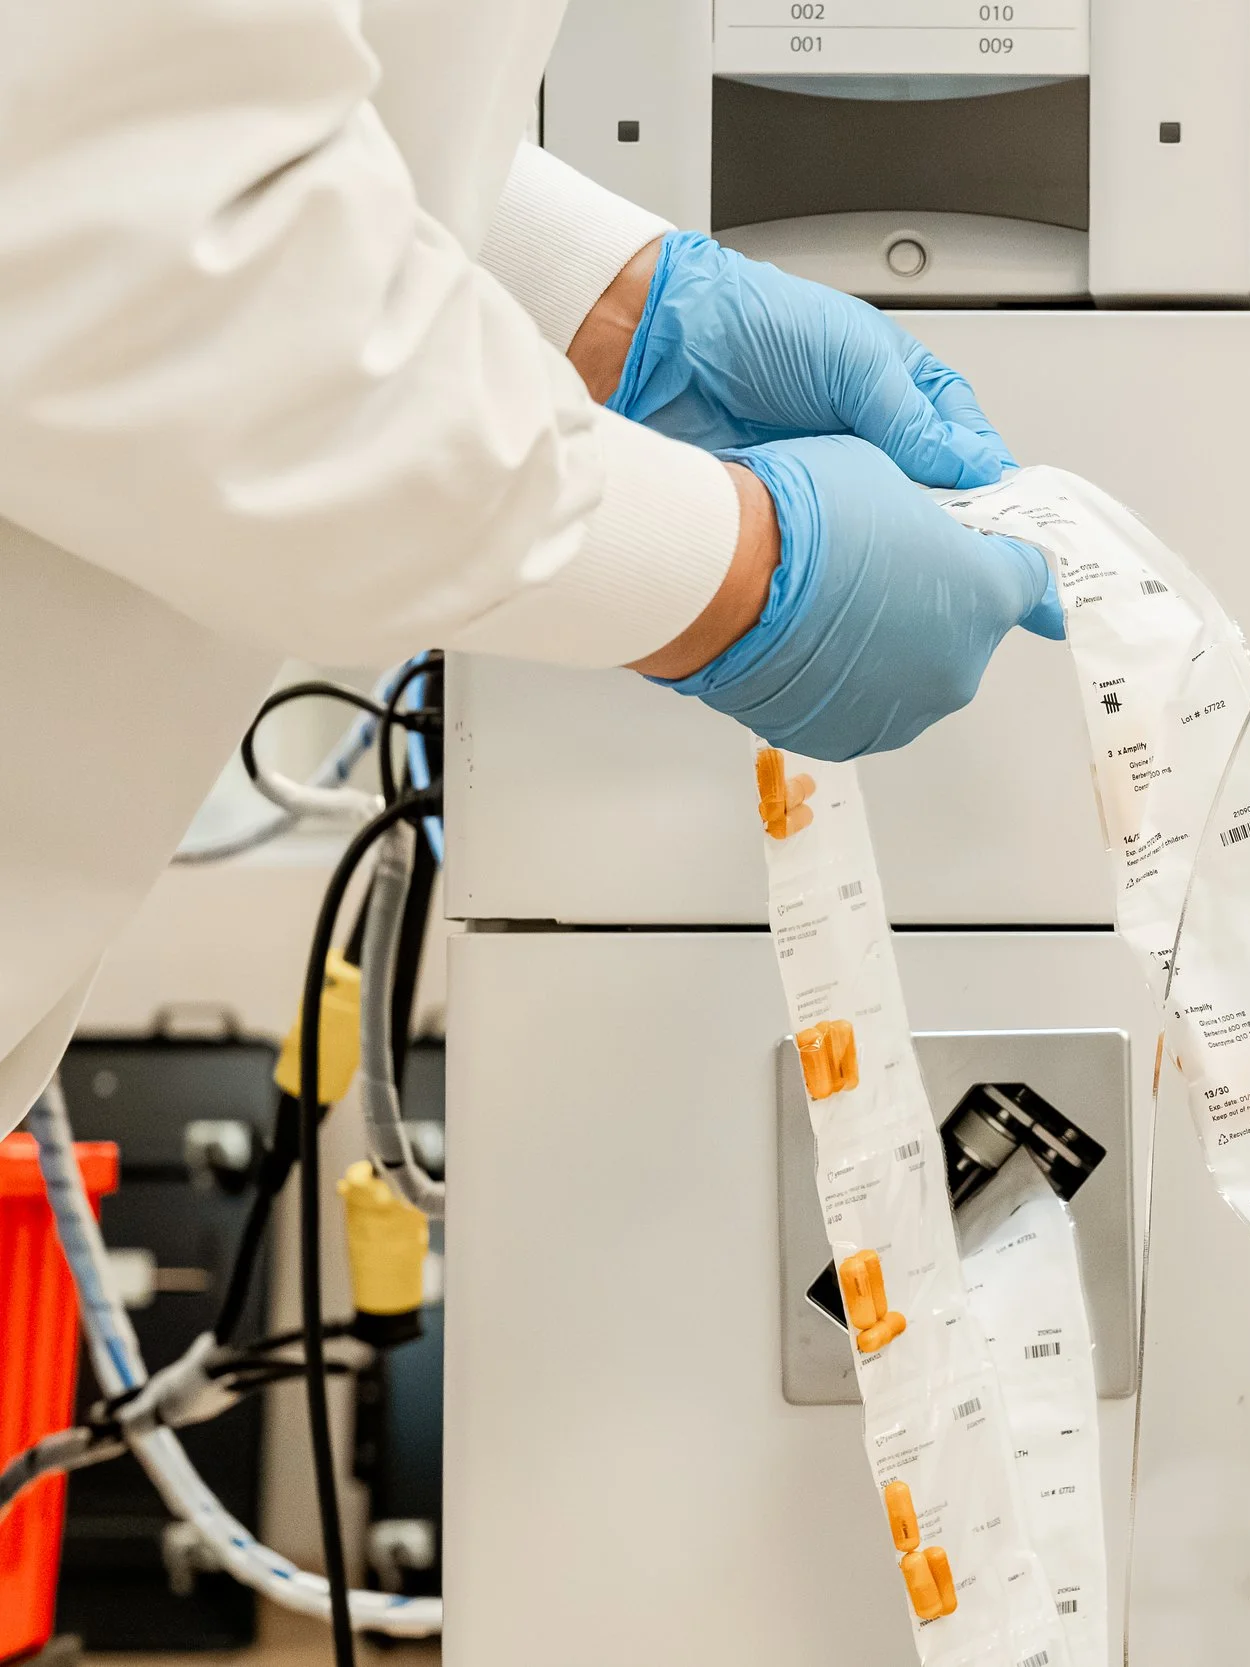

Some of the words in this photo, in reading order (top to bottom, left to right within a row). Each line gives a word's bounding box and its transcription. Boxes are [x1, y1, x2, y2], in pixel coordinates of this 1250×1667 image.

[791, 4, 825, 21] 002
[979, 5, 1014, 22] 010
[791, 36, 822, 53] 001
[979, 38, 1013, 54] 009
[1099, 678, 1126, 689] SEPARATE
[1181, 715, 1193, 725] Lot
[1194, 711, 1201, 719] #
[1204, 700, 1227, 715] 67722
[1107, 750, 1114, 758] 3
[1123, 742, 1147, 755] Amplify
[1174, 1011, 1181, 1020] 3
[1190, 1003, 1214, 1014] Amplify
[1236, 1010, 1247, 1018] mg
[1208, 1038, 1235, 1049] Coenzyme
[1235, 1033, 1248, 1043] Q10
[1204, 1086, 1230, 1100] 13/30
[1209, 1104, 1224, 1113] Exp.
[1212, 1113, 1228, 1123] Keep
[1228, 1109, 1240, 1118] out
[1240, 1106, 1246, 1114] of
[1015, 1449, 1029, 1460] LTH
